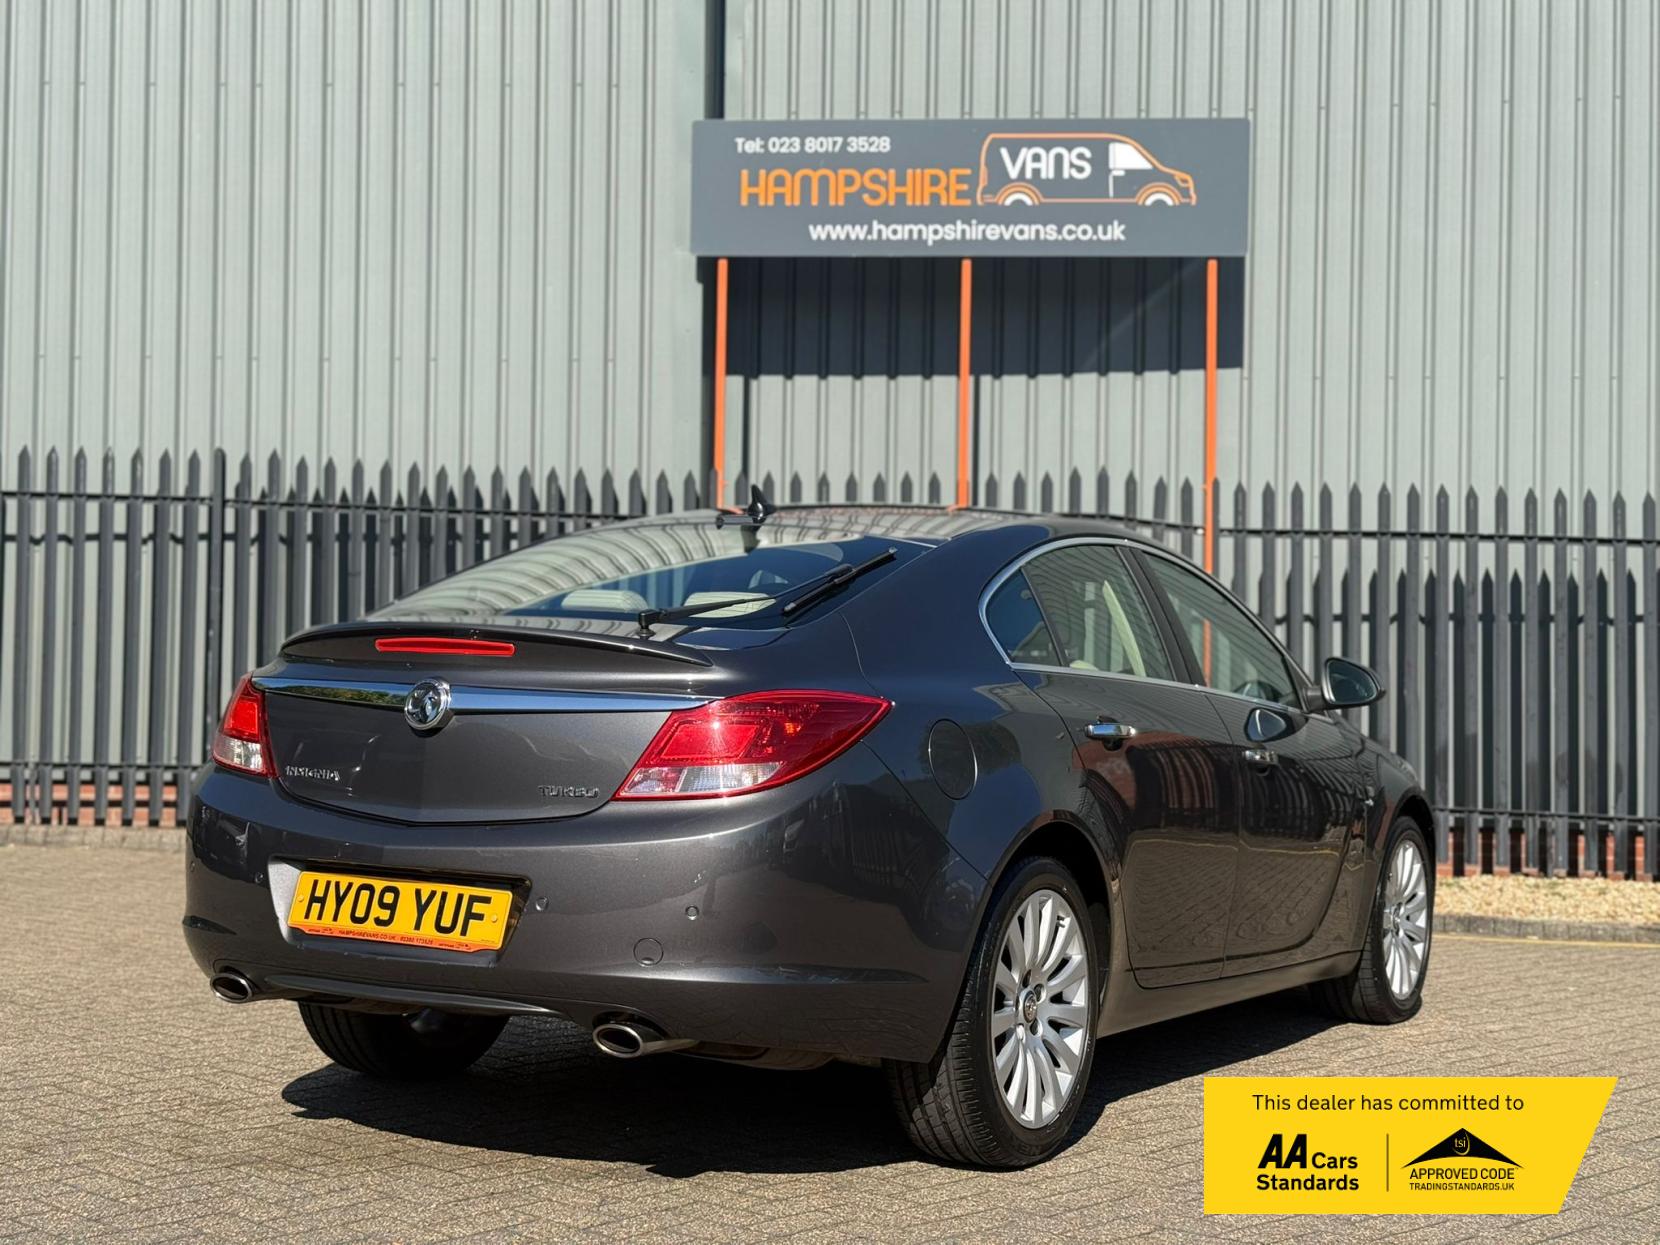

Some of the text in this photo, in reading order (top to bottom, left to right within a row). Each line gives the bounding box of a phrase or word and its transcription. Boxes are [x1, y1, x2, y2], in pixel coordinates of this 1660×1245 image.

[735, 136, 891, 153] Tel: 023 8017 3528
[1000, 146, 1092, 180] VANS
[740, 168, 972, 206] HAMPSHIRE
[808, 219, 1126, 246] www.hampshirevans.co.uk
[285, 765, 341, 781] INSIGNIA
[303, 879, 492, 937] HY09 YUF
